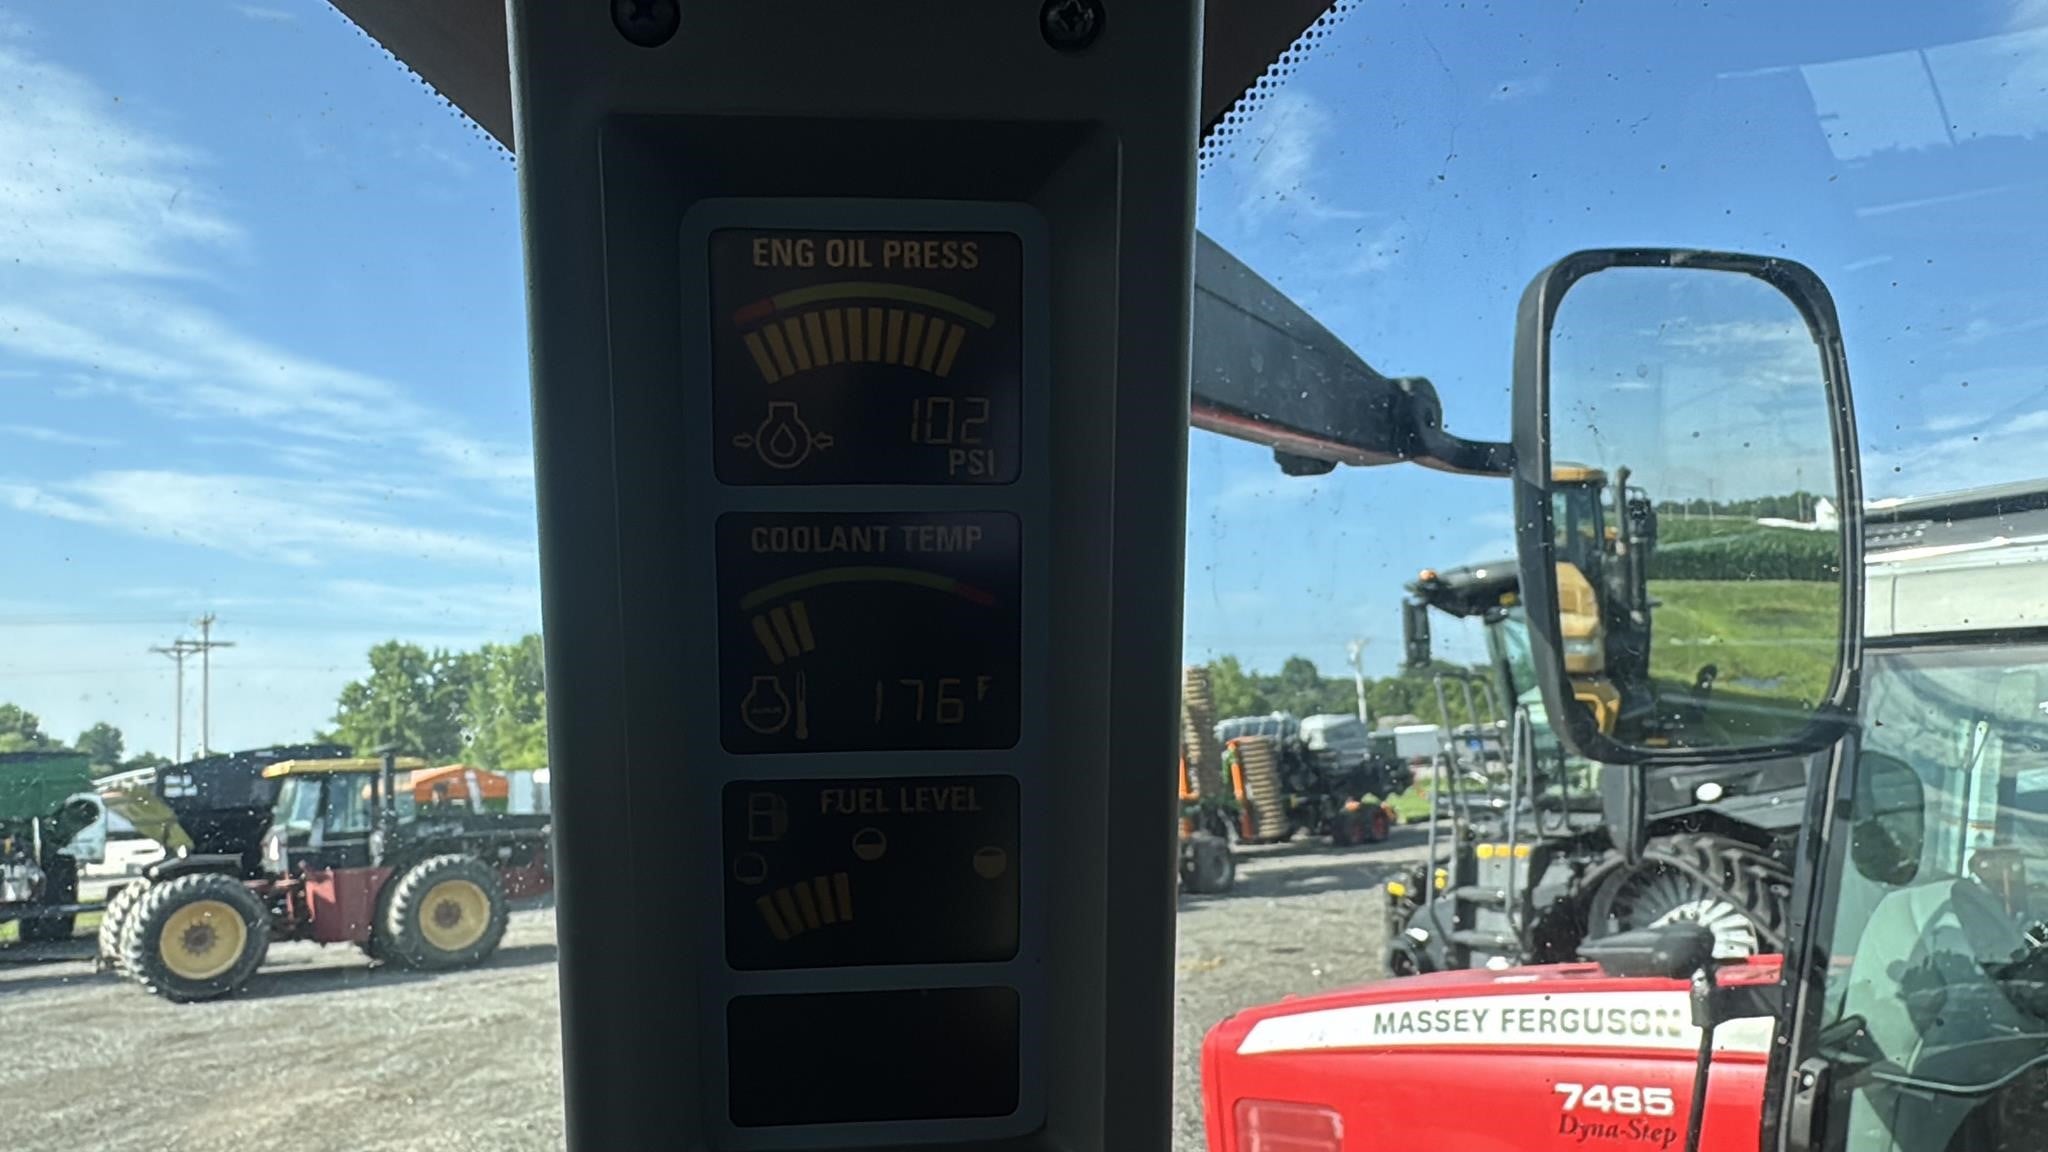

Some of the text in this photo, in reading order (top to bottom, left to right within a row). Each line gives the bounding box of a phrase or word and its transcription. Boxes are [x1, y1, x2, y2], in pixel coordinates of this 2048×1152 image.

[752, 238, 979, 269] ENG OIL PRESS
[912, 397, 989, 444] 102
[949, 448, 994, 475] PSI
[751, 525, 983, 552] COOLANT TEMP
[875, 677, 964, 724] 176
[820, 784, 983, 815] FUEL LEVEL
[1373, 1008, 1490, 1034] MASSEY
[1554, 1083, 1674, 1117] 7485
[1558, 1114, 1677, 1149] Dyna-Step
